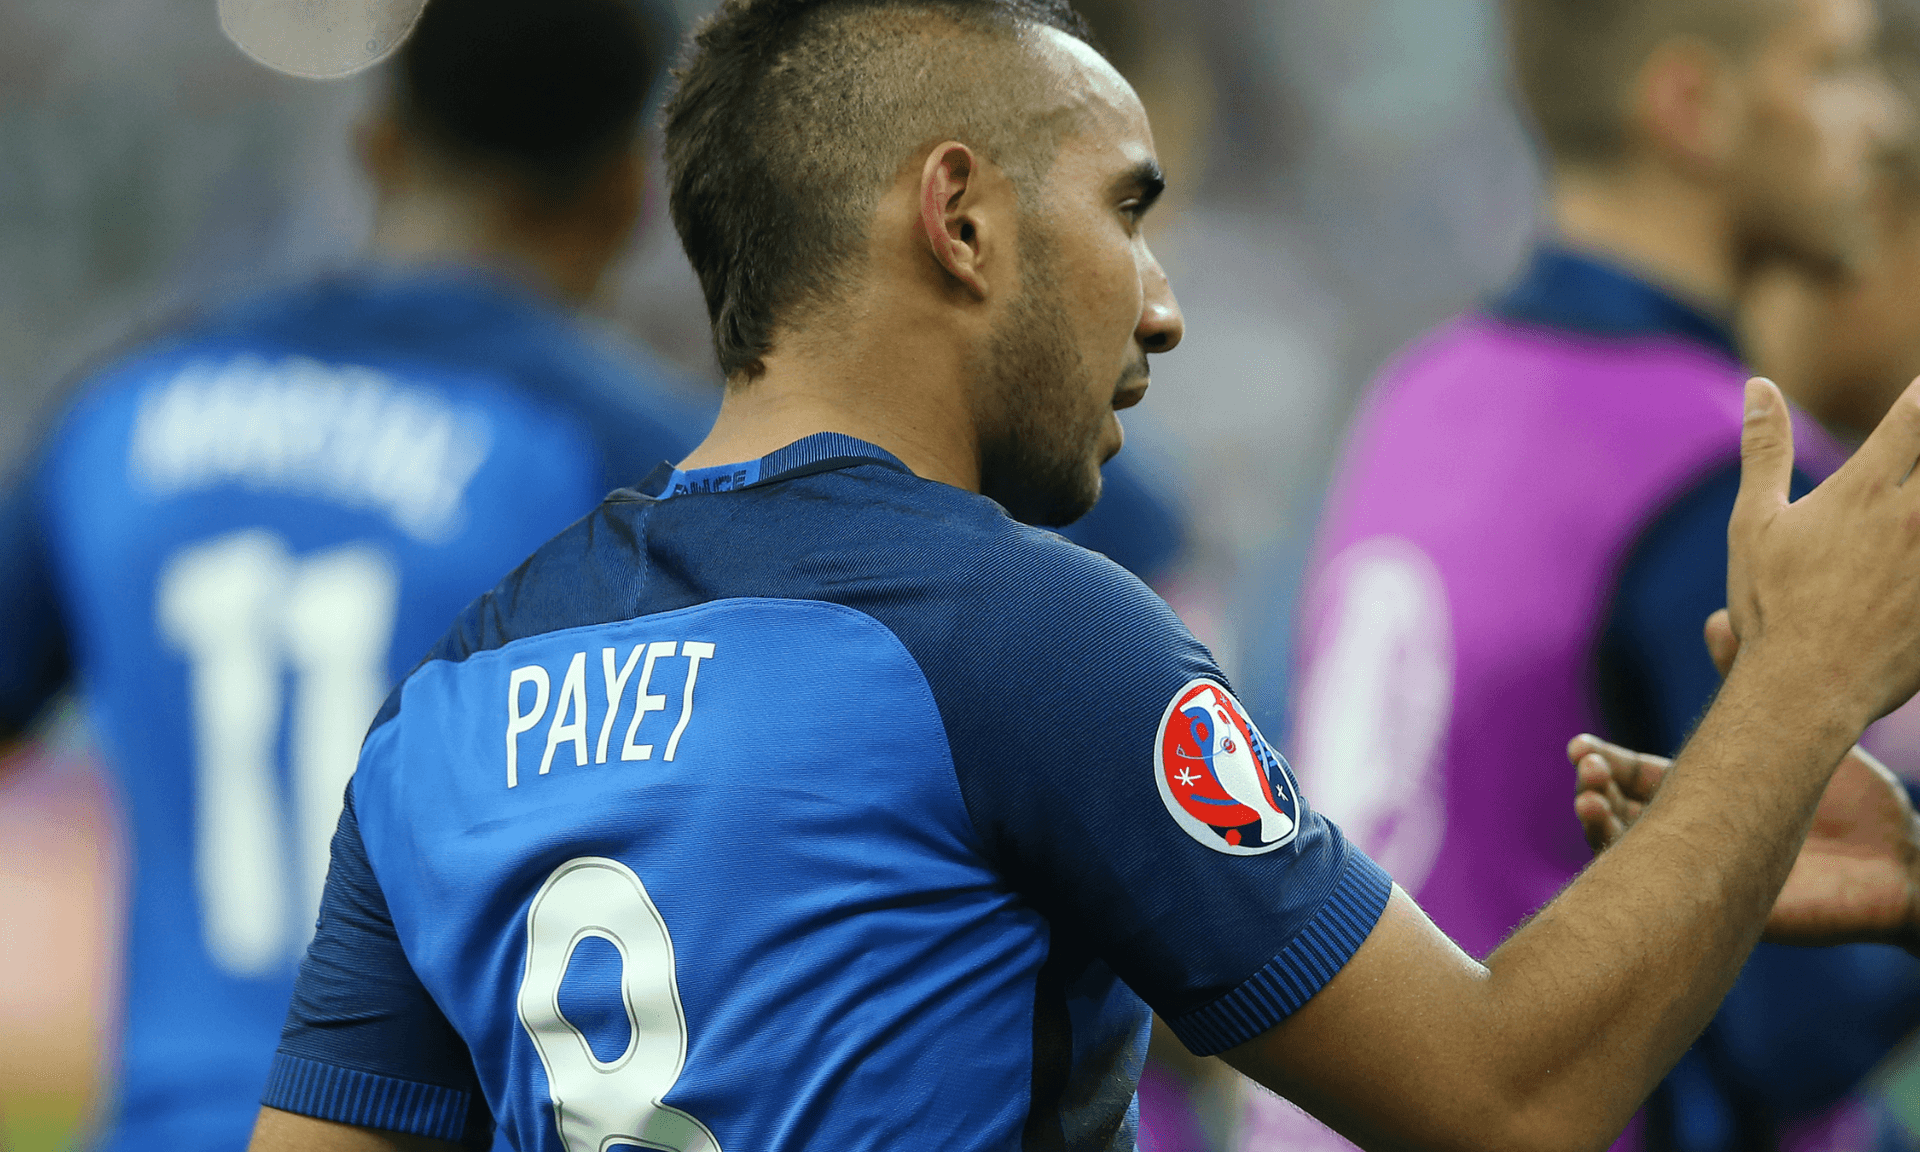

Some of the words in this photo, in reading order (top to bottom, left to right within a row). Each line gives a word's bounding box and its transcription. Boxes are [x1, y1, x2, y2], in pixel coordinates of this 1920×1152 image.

[157, 529, 397, 976] 11
[506, 640, 716, 789] PAYET
[517, 856, 723, 1152] 8
